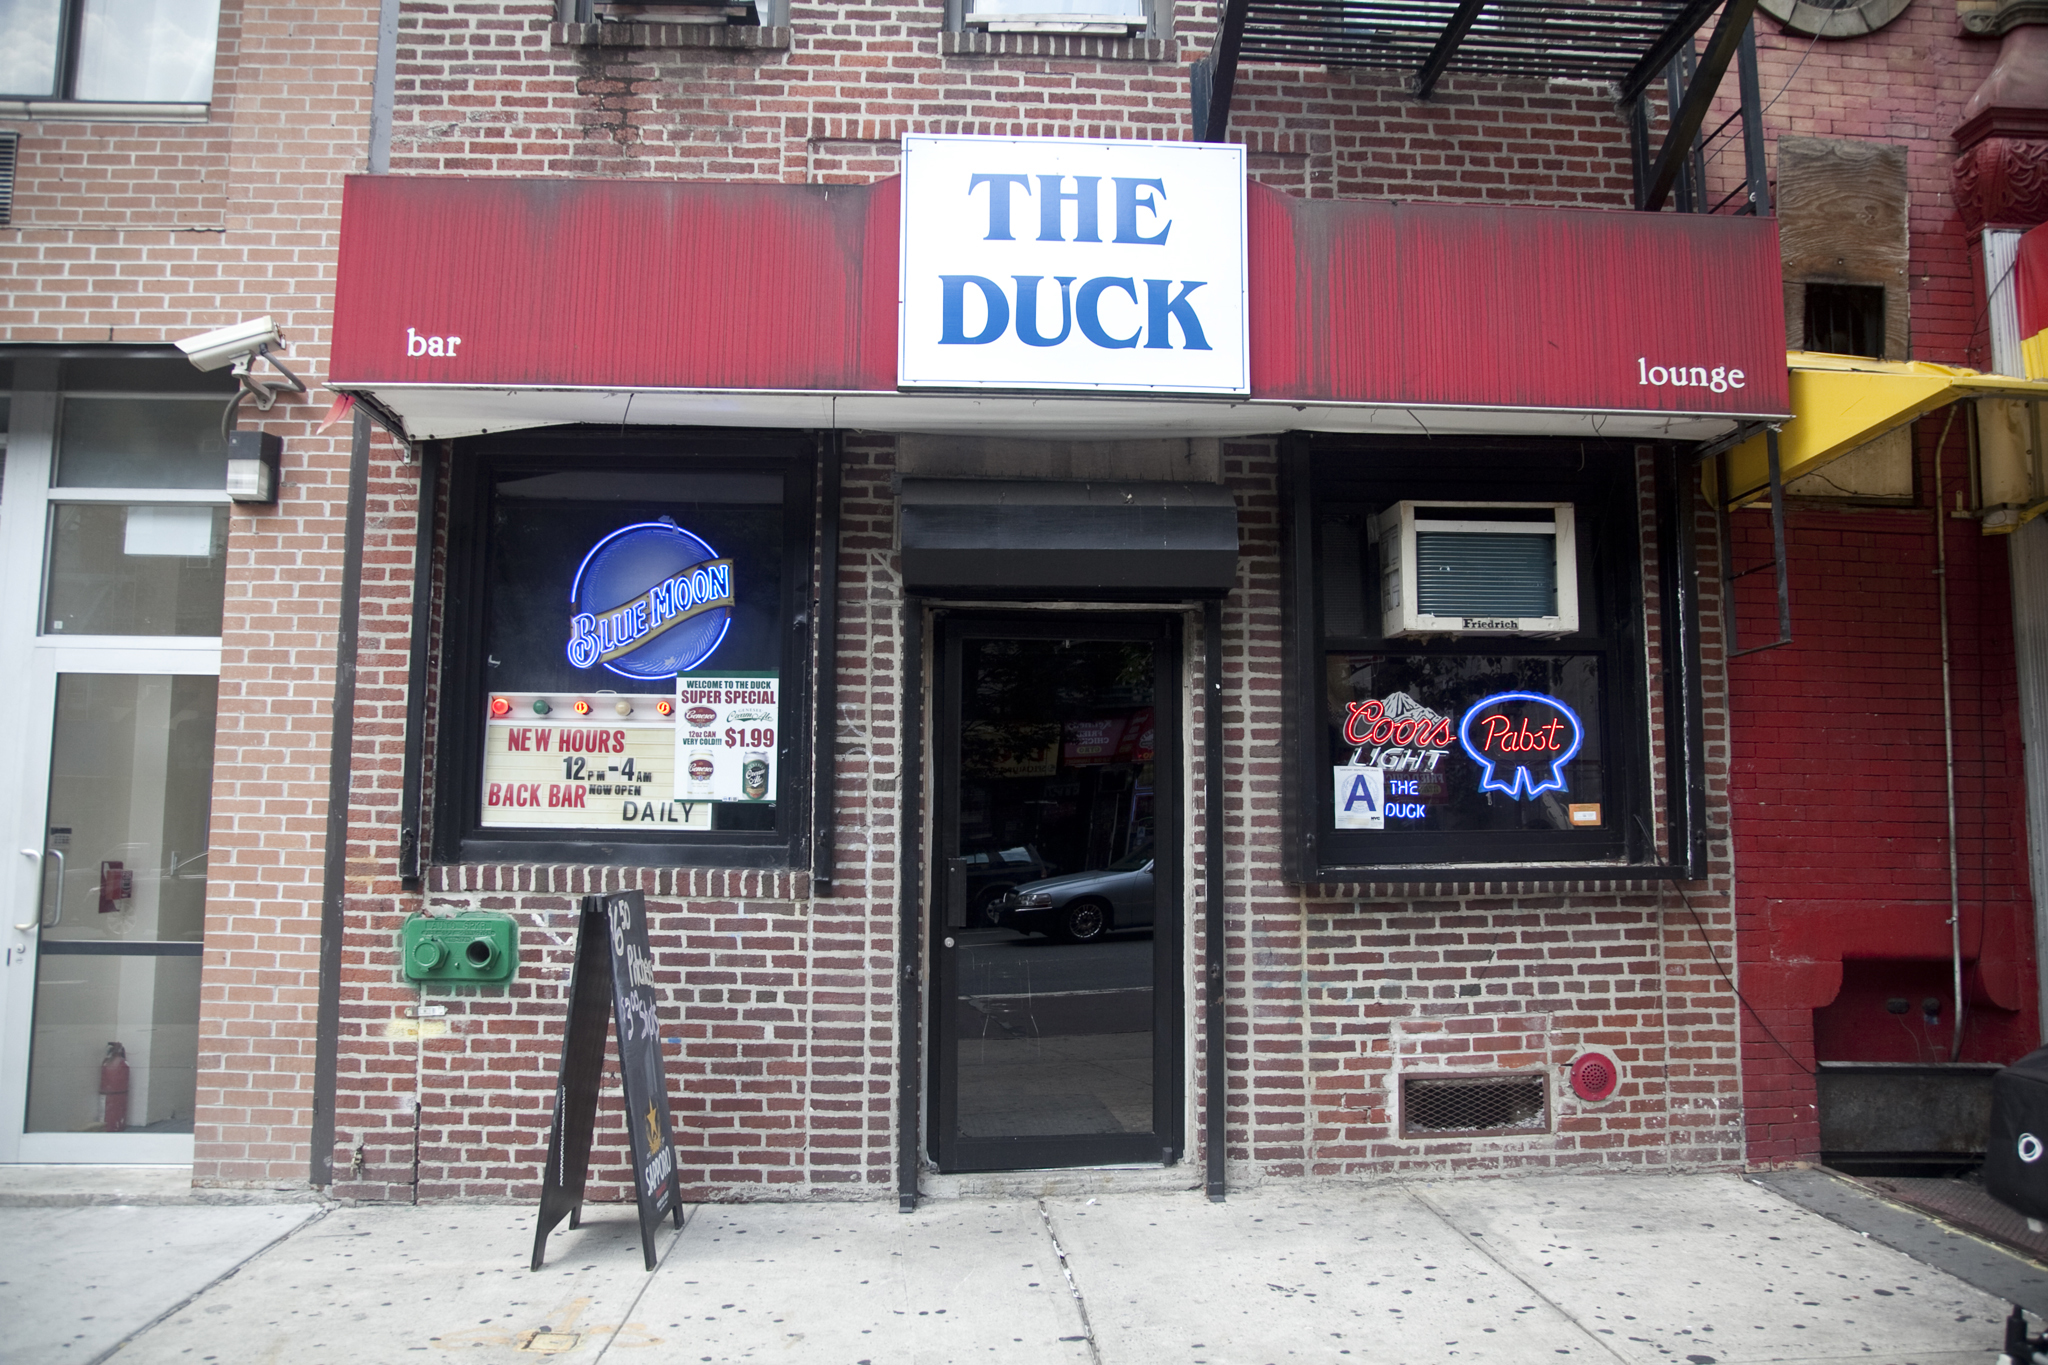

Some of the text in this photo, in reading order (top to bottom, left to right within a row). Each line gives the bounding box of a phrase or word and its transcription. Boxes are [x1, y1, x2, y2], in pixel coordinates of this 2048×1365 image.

[968, 173, 1172, 246] THE
[937, 274, 1213, 351] DUCK
[407, 327, 462, 357] bar
[1638, 357, 1745, 393] lounge
[567, 564, 731, 669] BLUE MOON
[1463, 618, 1519, 630] Friedrich
[681, 690, 776, 704] SUPER SPECIAL
[686, 680, 771, 690] WELCOME TO THE DUCK
[1344, 699, 1456, 748] Coors
[1481, 714, 1564, 752] Pabst
[508, 728, 626, 753] NEW HOURS
[683, 738, 722, 746] VERY COLD!!!
[725, 727, 775, 749] $1.99
[1348, 747, 1449, 772] LIGHT
[488, 783, 641, 808] BACK BAR NOW OPEN
[1343, 774, 1377, 812] A
[1389, 780, 1419, 796] THE
[622, 801, 695, 823] DAILY
[1384, 803, 1426, 819] DUCK
[431, 921, 457, 930] AUTO
[645, 1145, 671, 1197] SAPPORO
